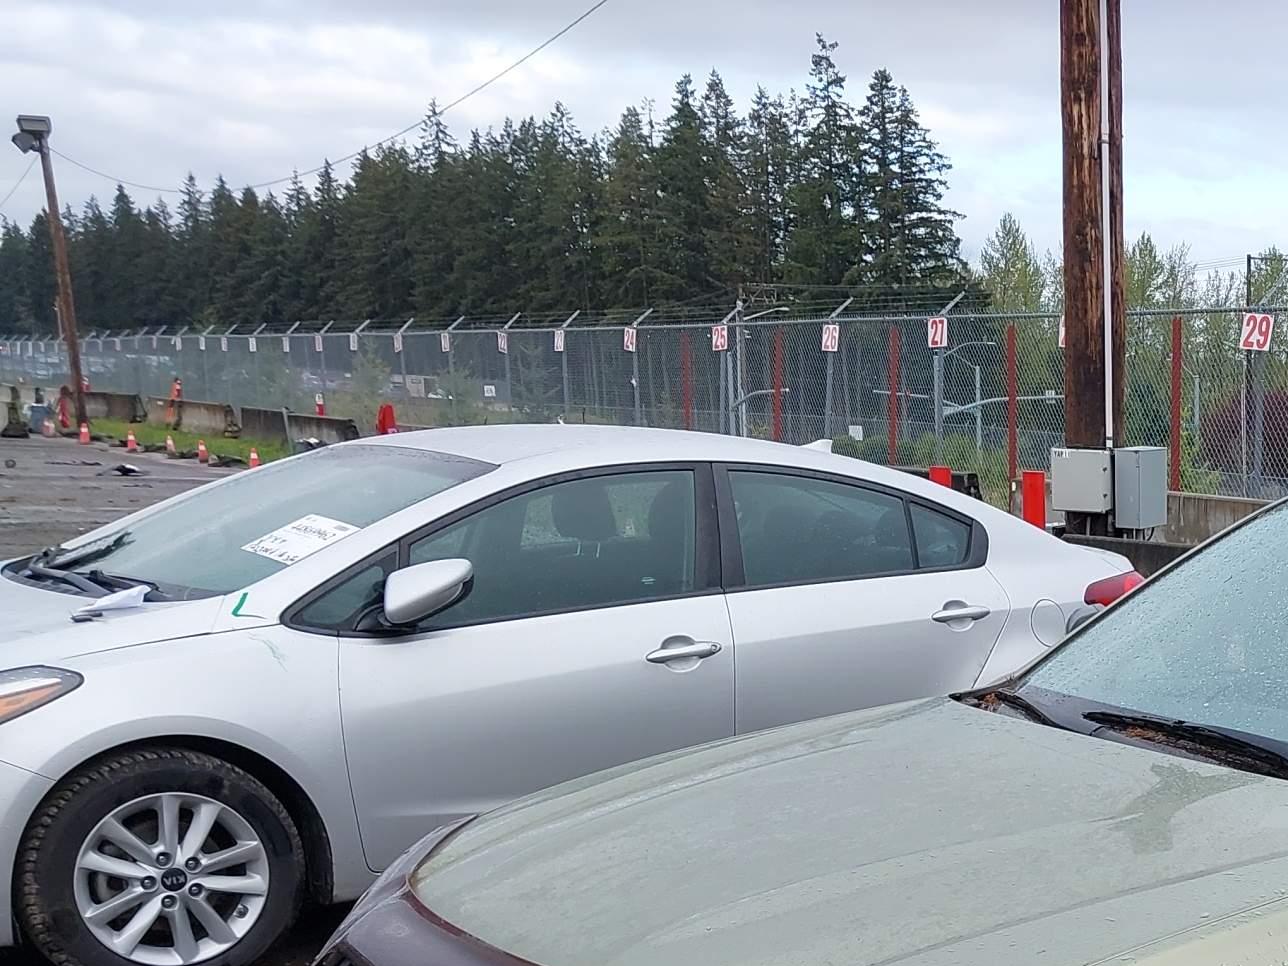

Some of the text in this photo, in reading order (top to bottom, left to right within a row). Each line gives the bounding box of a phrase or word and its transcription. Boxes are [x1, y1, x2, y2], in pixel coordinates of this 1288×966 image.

[625, 329, 635, 349] 24
[714, 327, 726, 349] 25
[824, 326, 837, 349] 26
[930, 319, 945, 346] 27
[1243, 315, 1270, 349] 29
[162, 874, 186, 886] KIA
